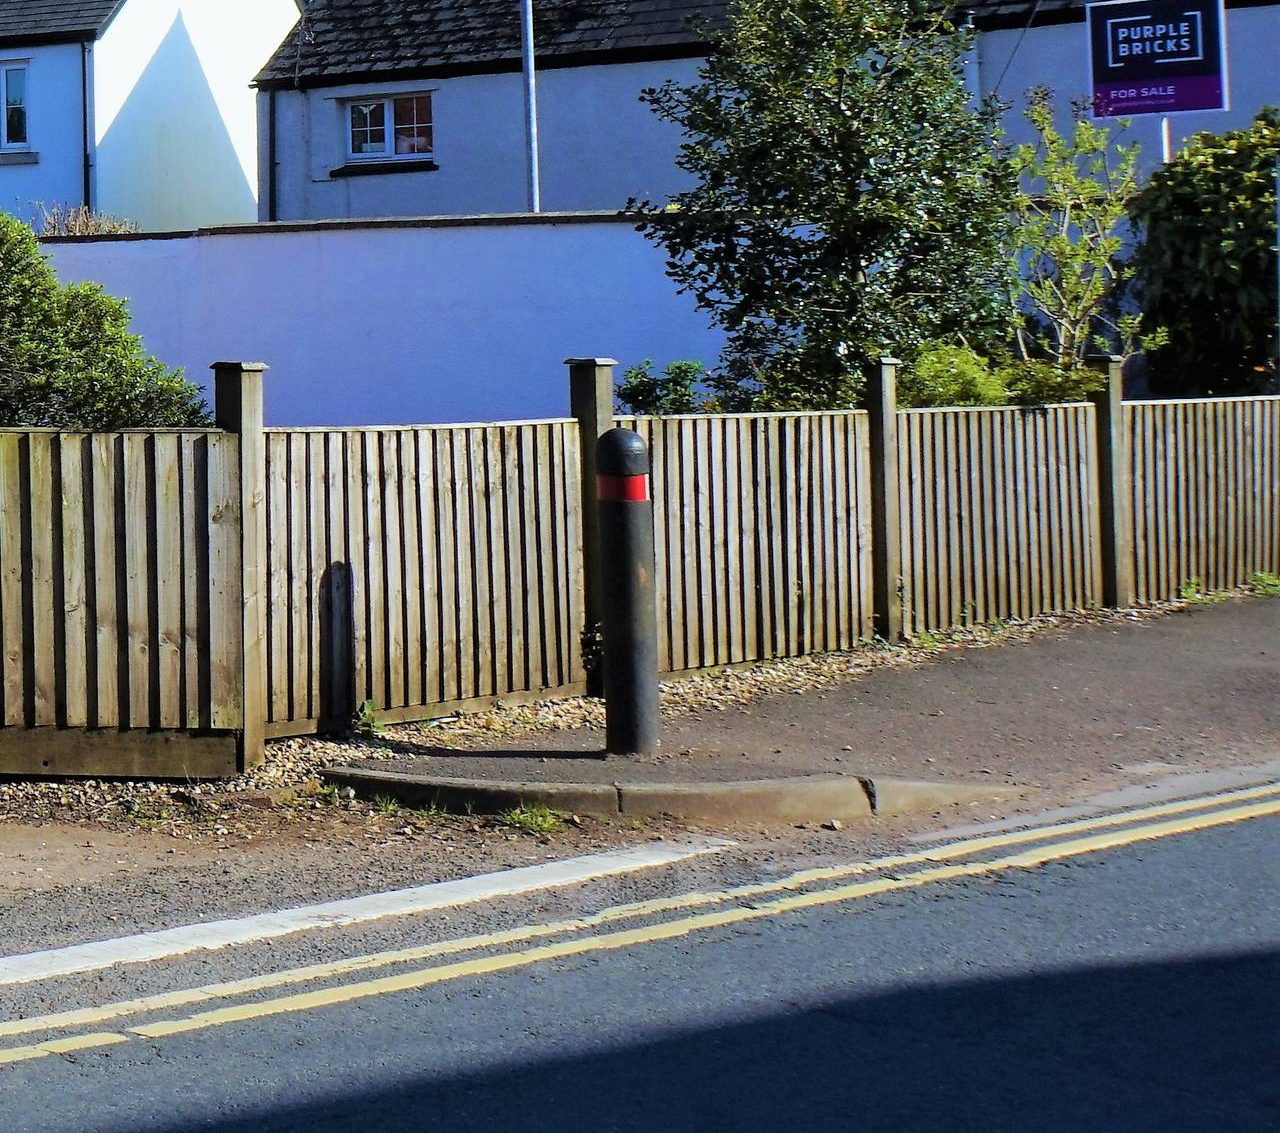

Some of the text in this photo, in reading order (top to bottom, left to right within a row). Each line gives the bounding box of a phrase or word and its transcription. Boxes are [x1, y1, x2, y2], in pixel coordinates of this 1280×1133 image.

[1118, 23, 1190, 41] PURPLE
[1118, 38, 1191, 56] BRICKS
[1110, 85, 1176, 99] FOR SALE
